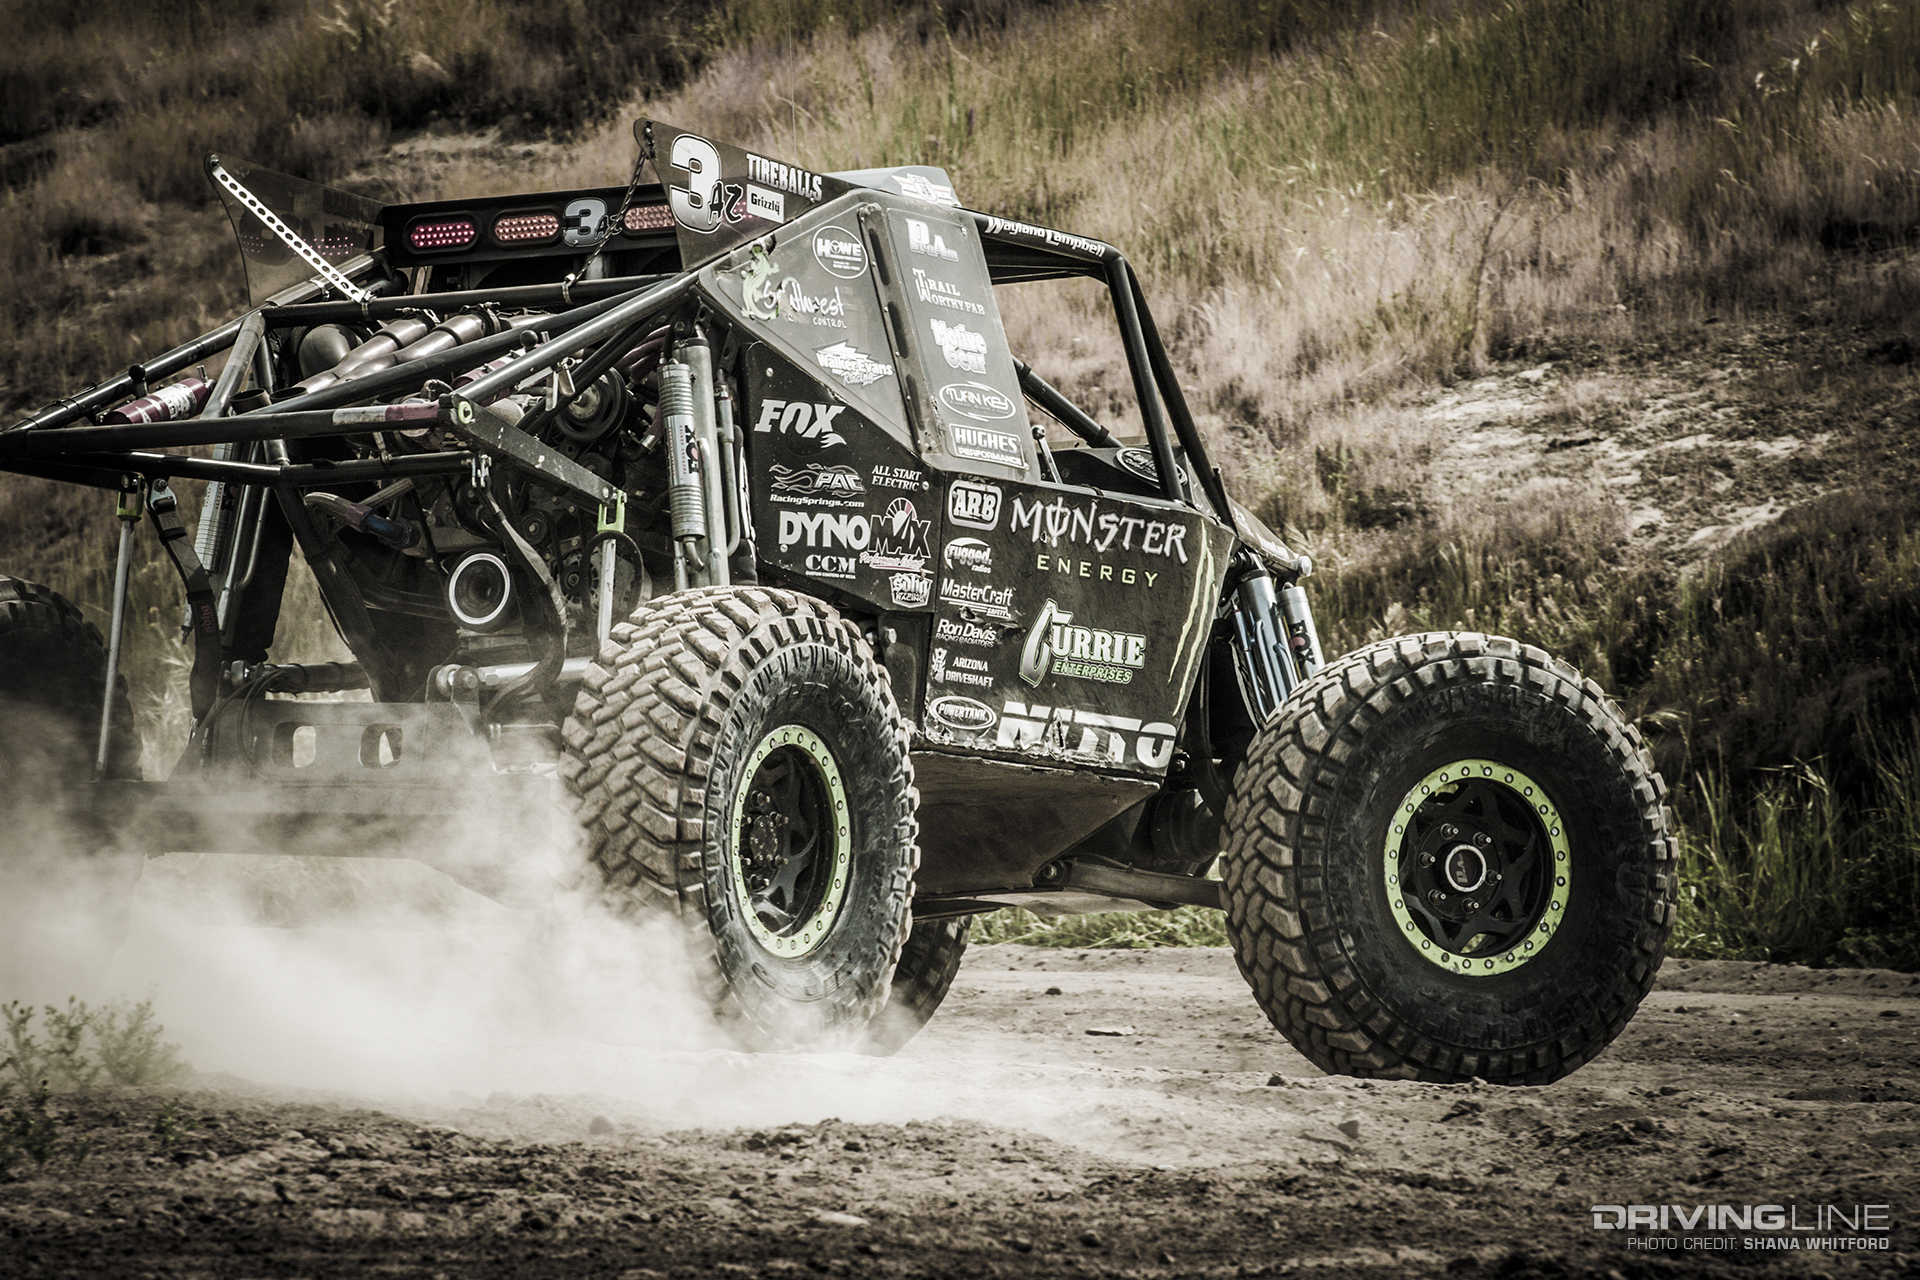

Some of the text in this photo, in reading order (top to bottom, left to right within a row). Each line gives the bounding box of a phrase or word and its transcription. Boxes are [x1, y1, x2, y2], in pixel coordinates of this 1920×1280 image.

[670, 134, 722, 234] 3
[746, 153, 822, 202] TIREBALLS
[750, 193, 780, 215] Grizzly
[562, 197, 607, 247] 3
[817, 238, 861, 258] HOWE
[984, 217, 1105, 258] Wayland Campbell
[912, 267, 960, 296] TRAIL
[915, 279, 986, 315] WORTHY FAB
[813, 317, 847, 329] CONTROL
[754, 399, 846, 438] FOX
[955, 428, 1017, 453] HUGHES
[958, 447, 1023, 466] PERFORMANCE
[815, 472, 866, 493] PAC
[872, 465, 921, 481] ALL START
[872, 476, 919, 491] ELECTRIC
[770, 494, 864, 508] RacingSprings.com
[953, 488, 996, 521] ARB
[1010, 496, 1188, 564] MONSTER
[805, 554, 856, 573] CCM
[948, 545, 992, 566] rugged
[972, 564, 991, 574] radios
[1037, 554, 1158, 588] ENERGY
[941, 578, 1013, 606] MasterCraft
[936, 633, 995, 647] RACING RADIATORS
[937, 619, 997, 641] Ron Davis
[1019, 598, 1146, 688] CURRIE
[953, 657, 988, 672] ARIZONA
[1052, 660, 1133, 684] ENTERPRISES
[945, 670, 993, 687] DRIVESHAFT
